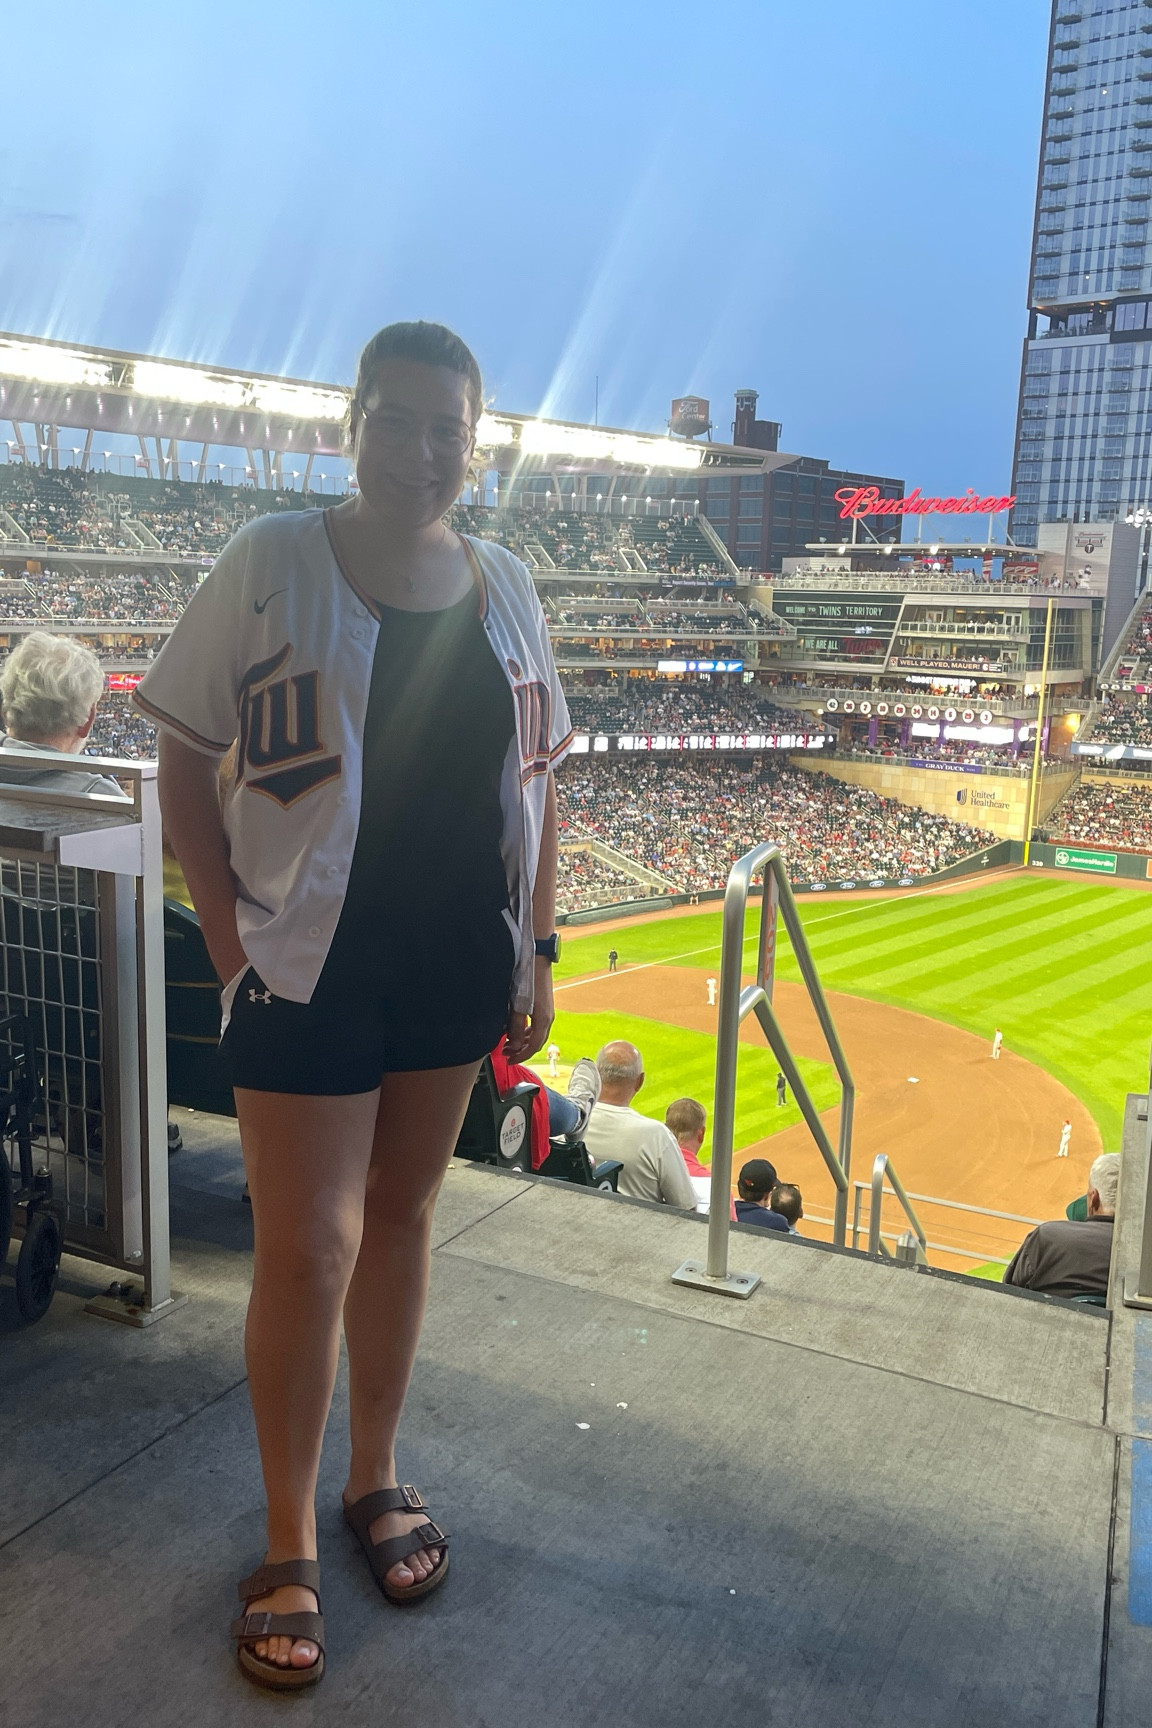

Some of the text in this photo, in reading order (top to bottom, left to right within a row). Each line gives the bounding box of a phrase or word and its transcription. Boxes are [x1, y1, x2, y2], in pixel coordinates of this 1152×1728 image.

[679, 401, 698, 413] Ford
[834, 486, 1017, 519] Budweiser
[785, 606, 806, 614] WELCOME
[819, 606, 841, 616] TWINS
[846, 606, 883, 616] TERRITORY
[805, 639, 814, 649] WE
[815, 640, 828, 650] ARE
[828, 640, 838, 650] ALL
[920, 660, 950, 668] PLAYED,
[951, 662, 980, 670] MAUER!
[971, 789, 996, 800] United
[970, 798, 1010, 810] Healthcare
[502, 1122, 524, 1140] TARGET
[504, 1131, 521, 1145] FIELD
